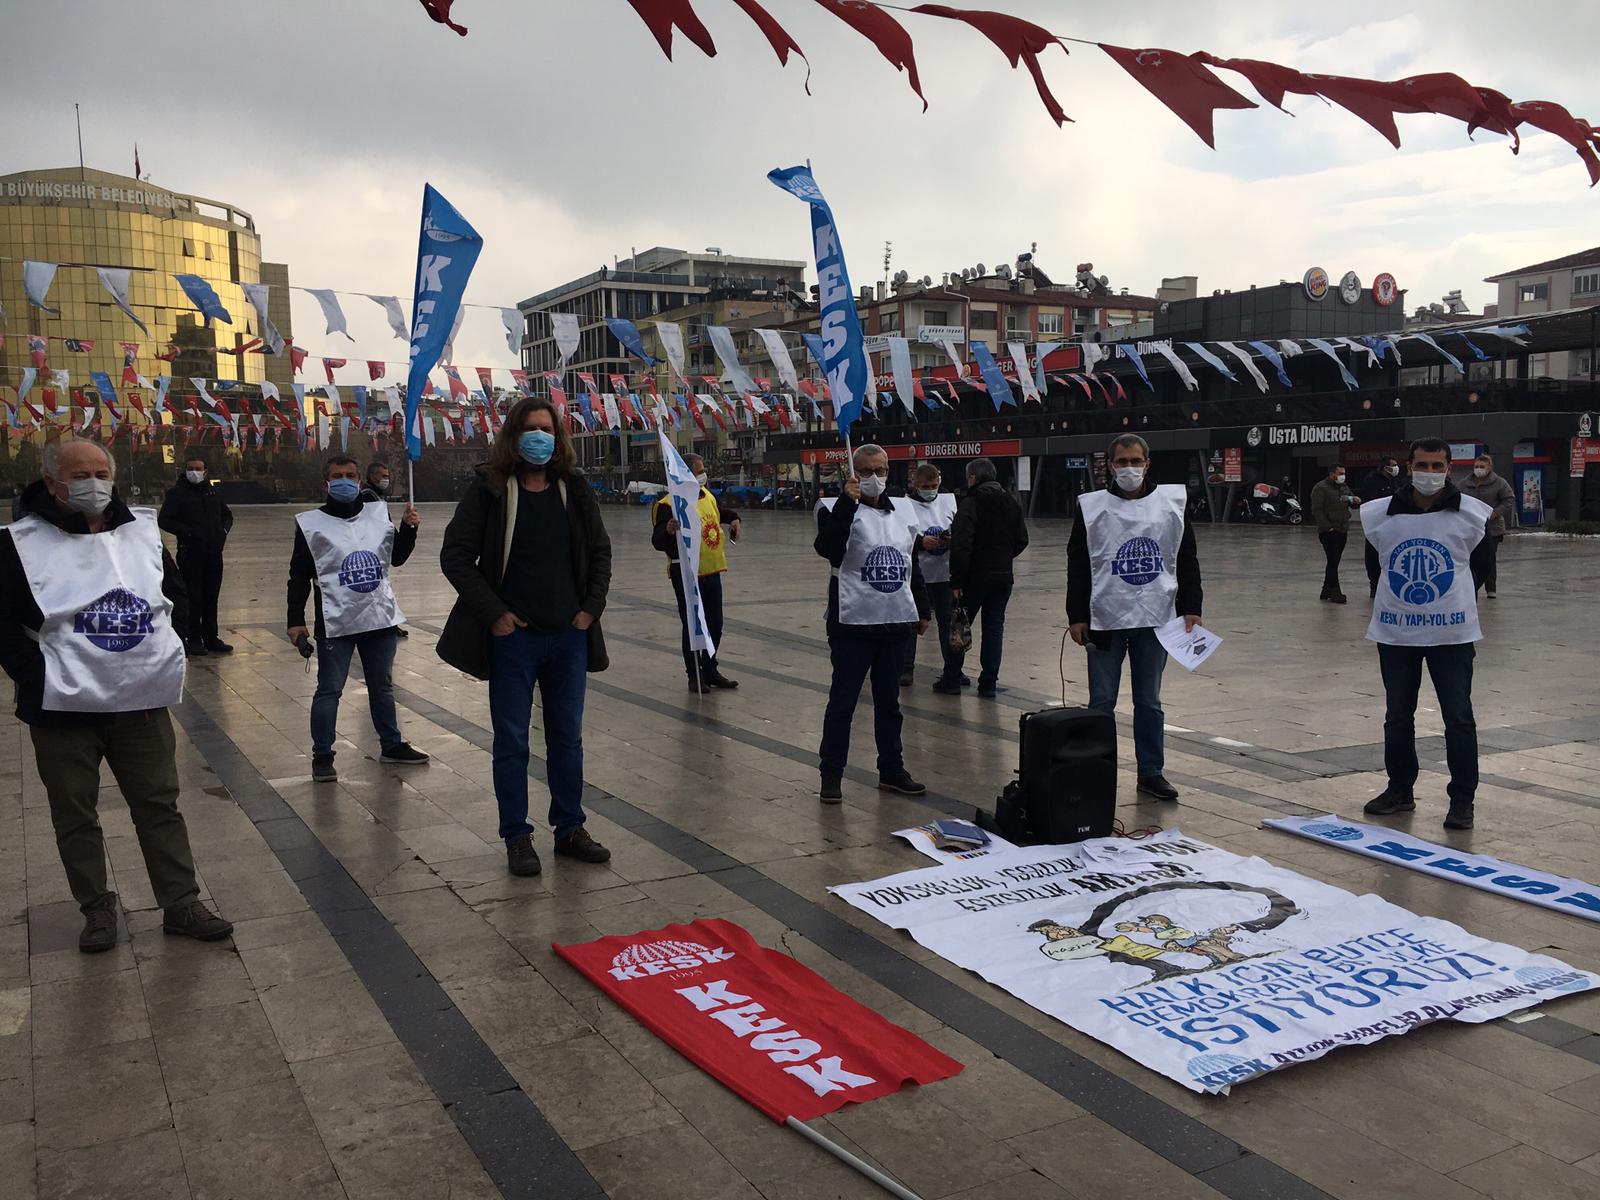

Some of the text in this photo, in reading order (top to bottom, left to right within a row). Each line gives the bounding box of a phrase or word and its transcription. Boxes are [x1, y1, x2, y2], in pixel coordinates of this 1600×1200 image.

[8, 181, 97, 201] BÜYÜKŞEHİR
[101, 186, 177, 209] BELEDİYESİ
[1269, 424, 1353, 445] USTA DÖNERCİ
[925, 443, 981, 456] BURGER KING
[338, 566, 384, 586] KESK
[860, 566, 907, 582] KESK
[1111, 557, 1164, 576] KESK
[73, 612, 155, 634] KESK
[1380, 611, 1398, 625] KESK
[1405, 614, 1448, 627] YAPI-YOL
[1450, 611, 1466, 625] SEN
[106, 640, 130, 649] 1995
[607, 947, 736, 981] KESK
[669, 969, 704, 982] 1995
[1099, 977, 1217, 1014] HALK
[674, 979, 877, 1098] KESK
[1193, 1058, 1274, 1088] KESK
